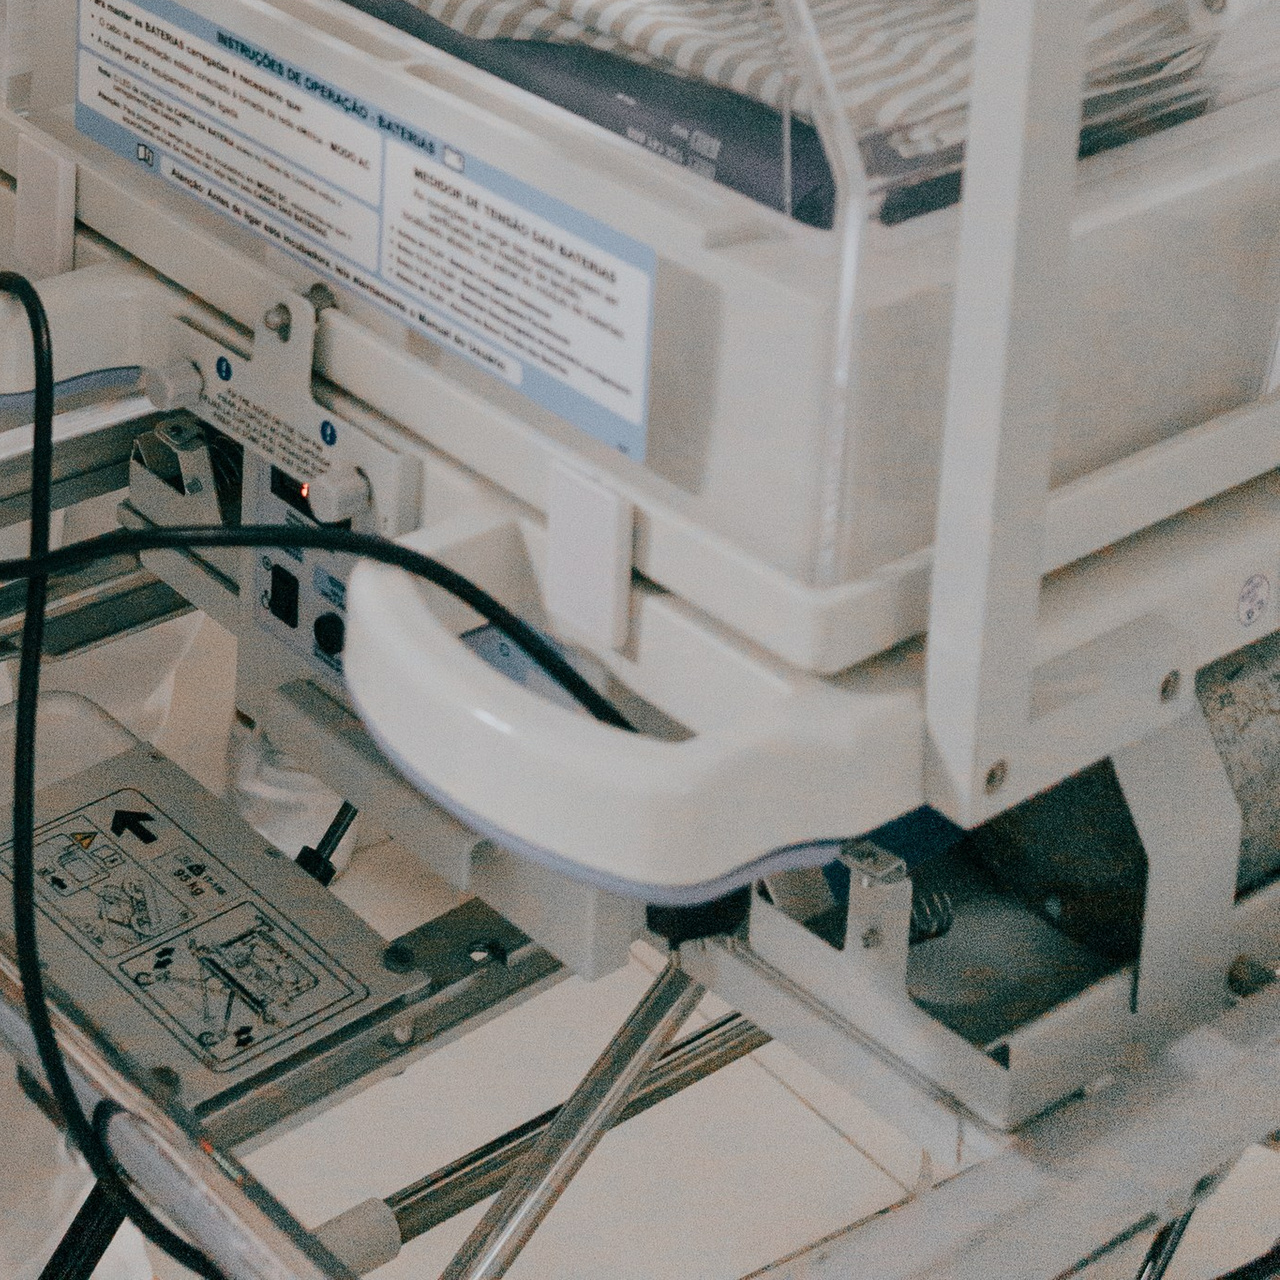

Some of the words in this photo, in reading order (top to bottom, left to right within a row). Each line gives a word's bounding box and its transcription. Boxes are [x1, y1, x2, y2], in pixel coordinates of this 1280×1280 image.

[107, 2, 132, 23] manter
[144, 20, 184, 51] BATERIAS
[216, 29, 284, 78] INSTRUÇÕES
[286, 65, 301, 87] DE
[304, 74, 368, 121] OPERAÇÃO
[377, 111, 434, 155] BATERIAS
[559, 242, 616, 284] BATERIAS
[187, 882, 205, 899] kg
